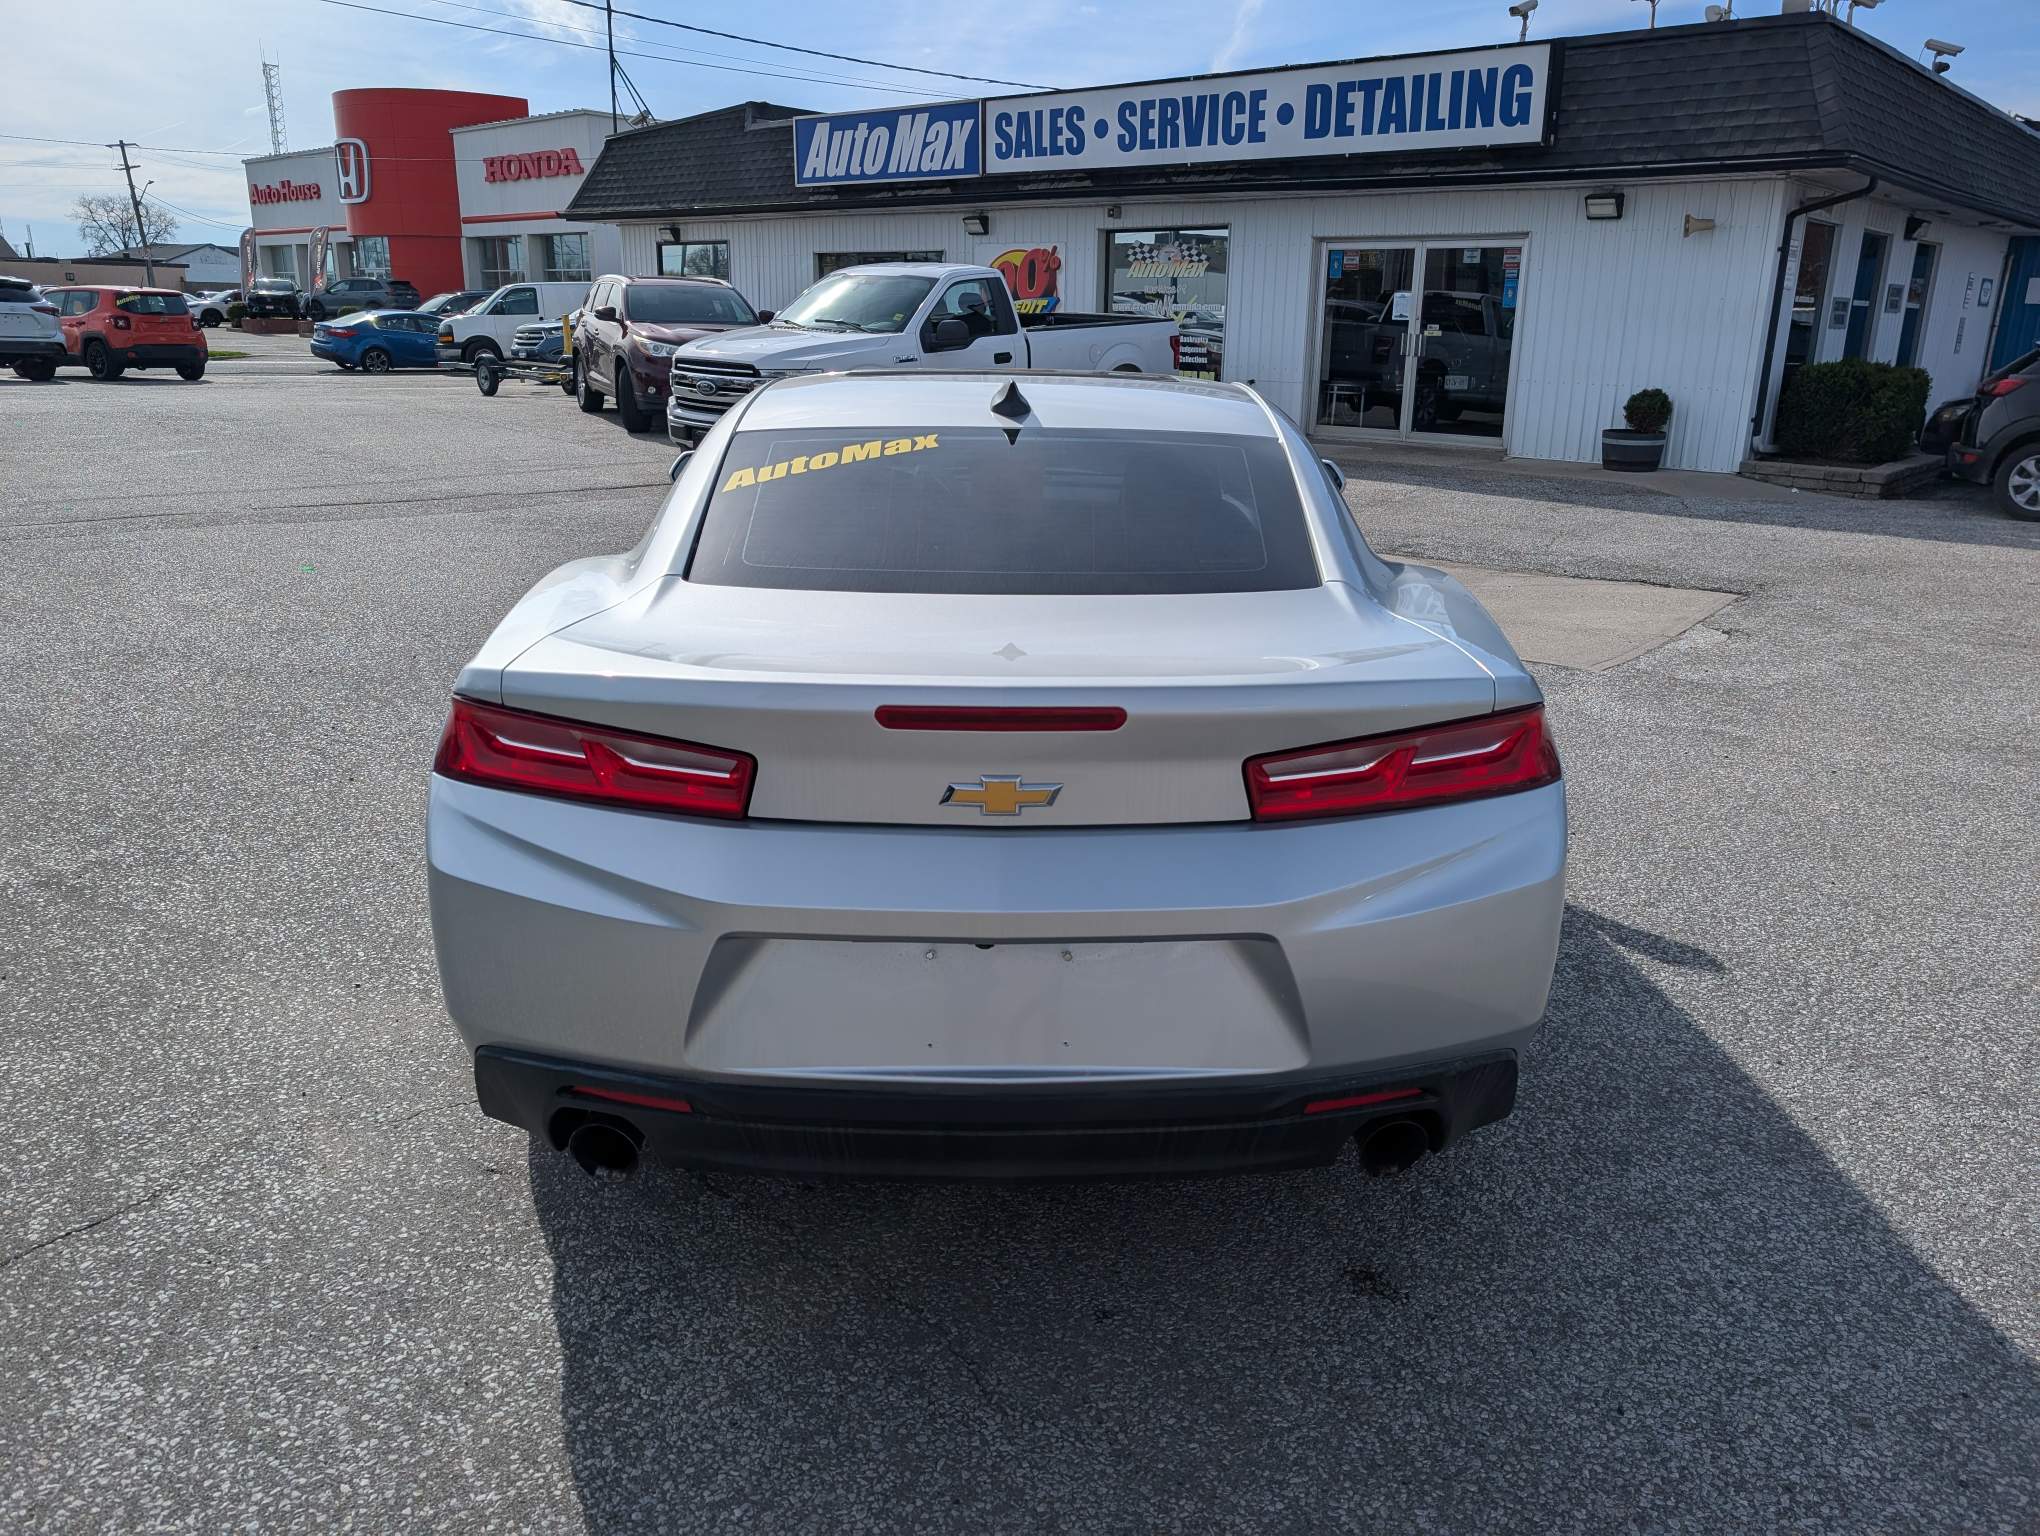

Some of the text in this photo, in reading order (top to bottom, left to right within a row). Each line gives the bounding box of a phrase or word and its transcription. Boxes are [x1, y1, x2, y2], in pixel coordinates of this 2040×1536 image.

[994, 63, 1533, 160] SALES SERVICE DETAILING
[483, 147, 584, 184] HONDA
[803, 113, 974, 178] AutoMax
[1014, 299, 1048, 314] EDIT
[722, 434, 939, 493] AutoMax
